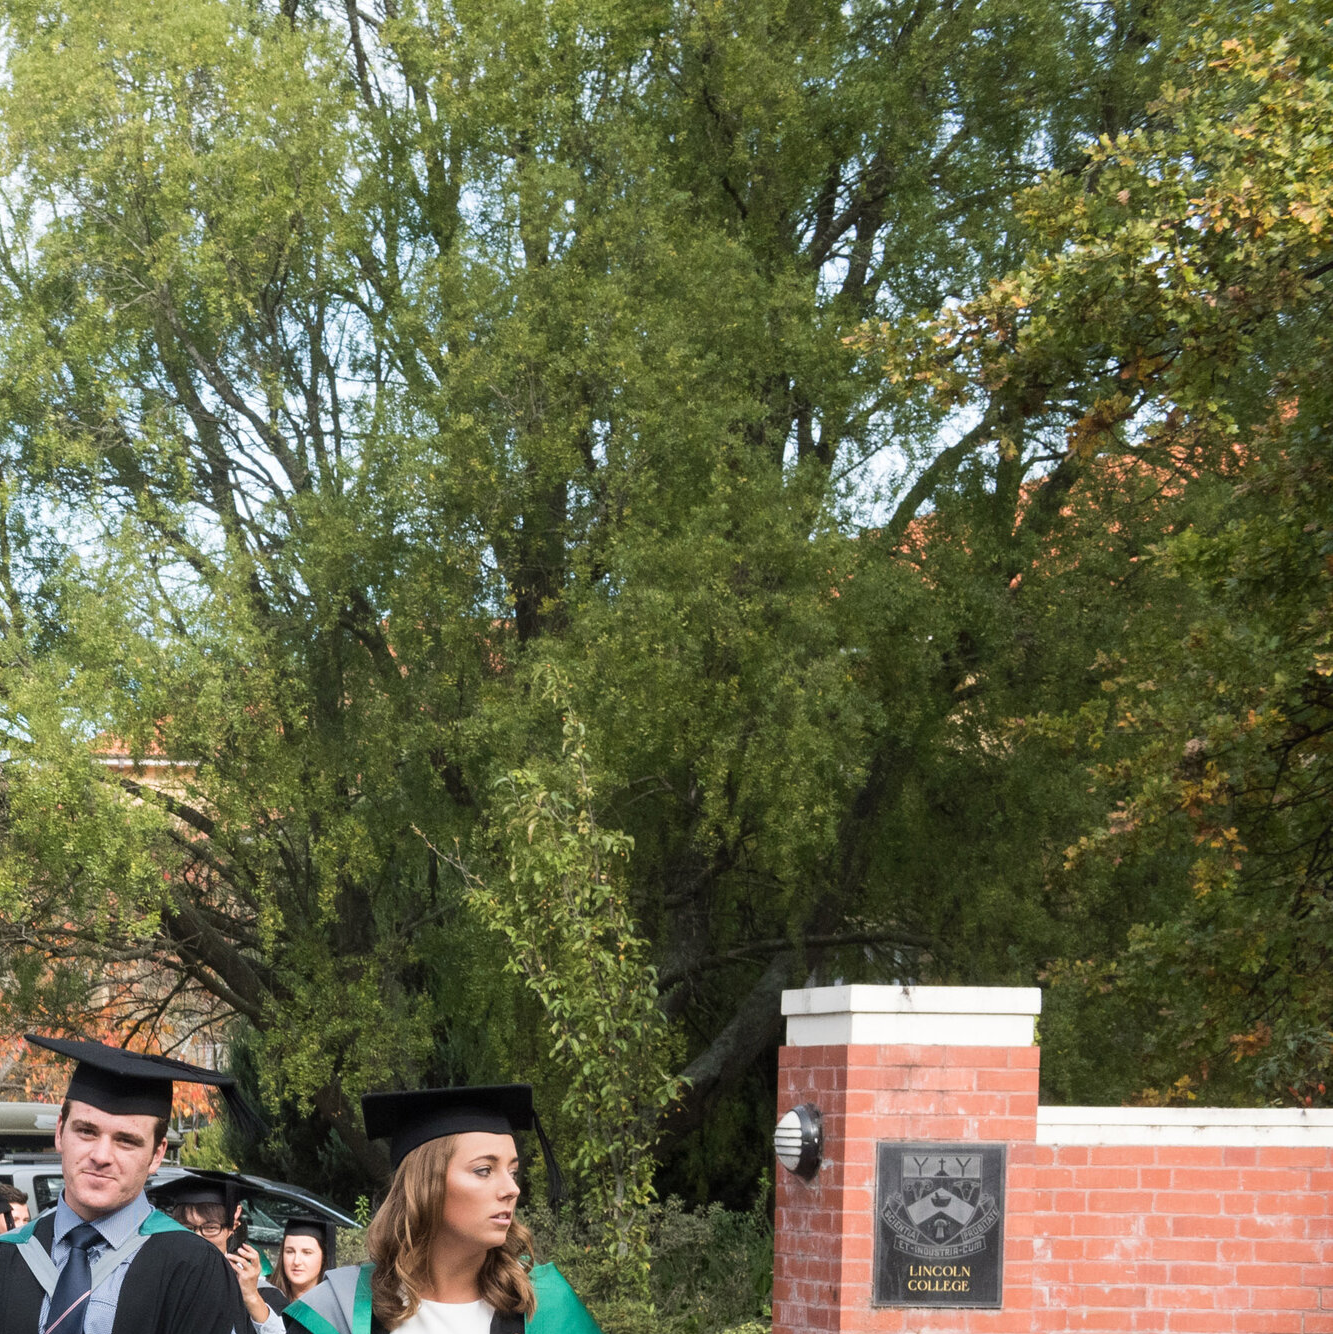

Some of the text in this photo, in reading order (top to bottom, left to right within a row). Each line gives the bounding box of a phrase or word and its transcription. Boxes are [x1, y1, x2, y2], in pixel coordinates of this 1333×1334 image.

[884, 1209, 916, 1239] SCIENTIA
[909, 1265, 971, 1277] LINCOLN
[907, 1279, 971, 1292] COLLEGE
